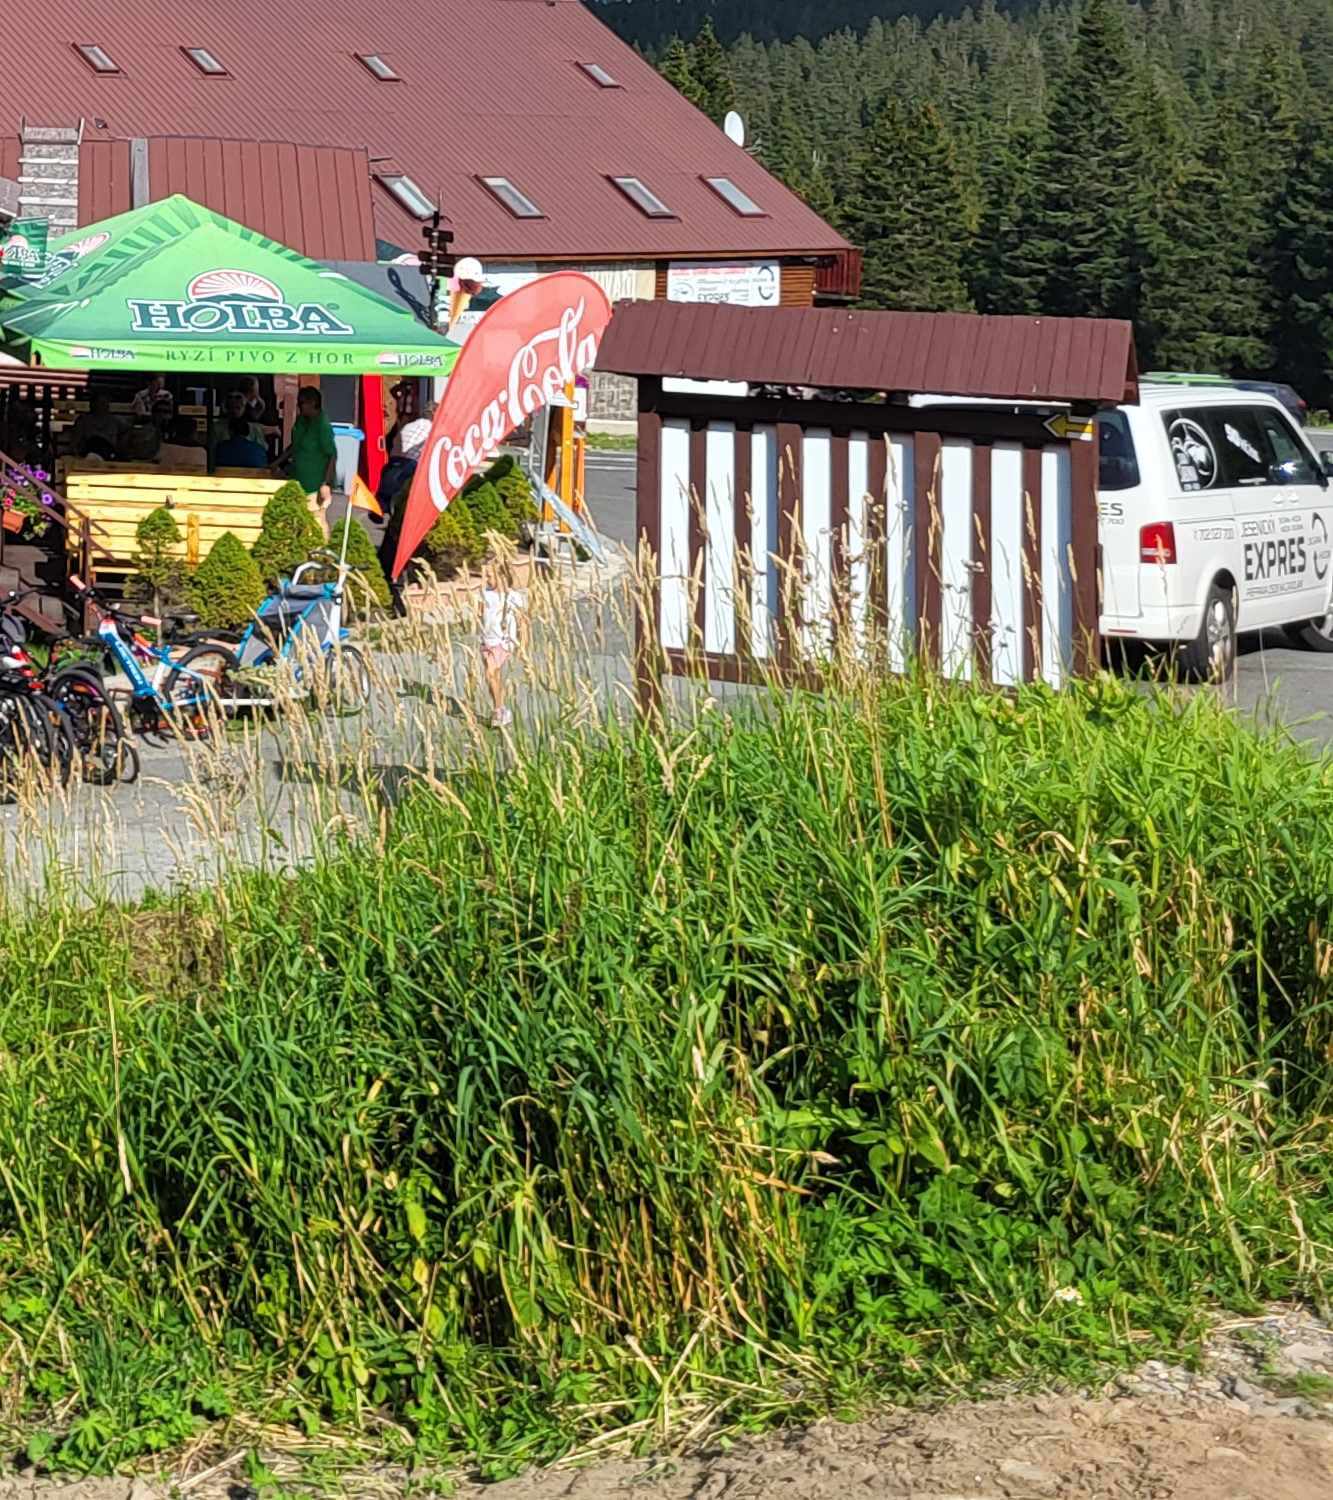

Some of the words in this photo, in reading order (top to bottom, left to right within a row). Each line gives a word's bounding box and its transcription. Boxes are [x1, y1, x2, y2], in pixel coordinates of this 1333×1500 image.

[126, 299, 355, 336] HOLBA
[165, 347, 215, 363] RYZÍ
[226, 350, 275, 364] PIVO
[286, 351, 298, 364] Z
[309, 351, 354, 365] HOR
[397, 354, 444, 367] HOLBA
[1243, 536, 1307, 581] EXPRES
